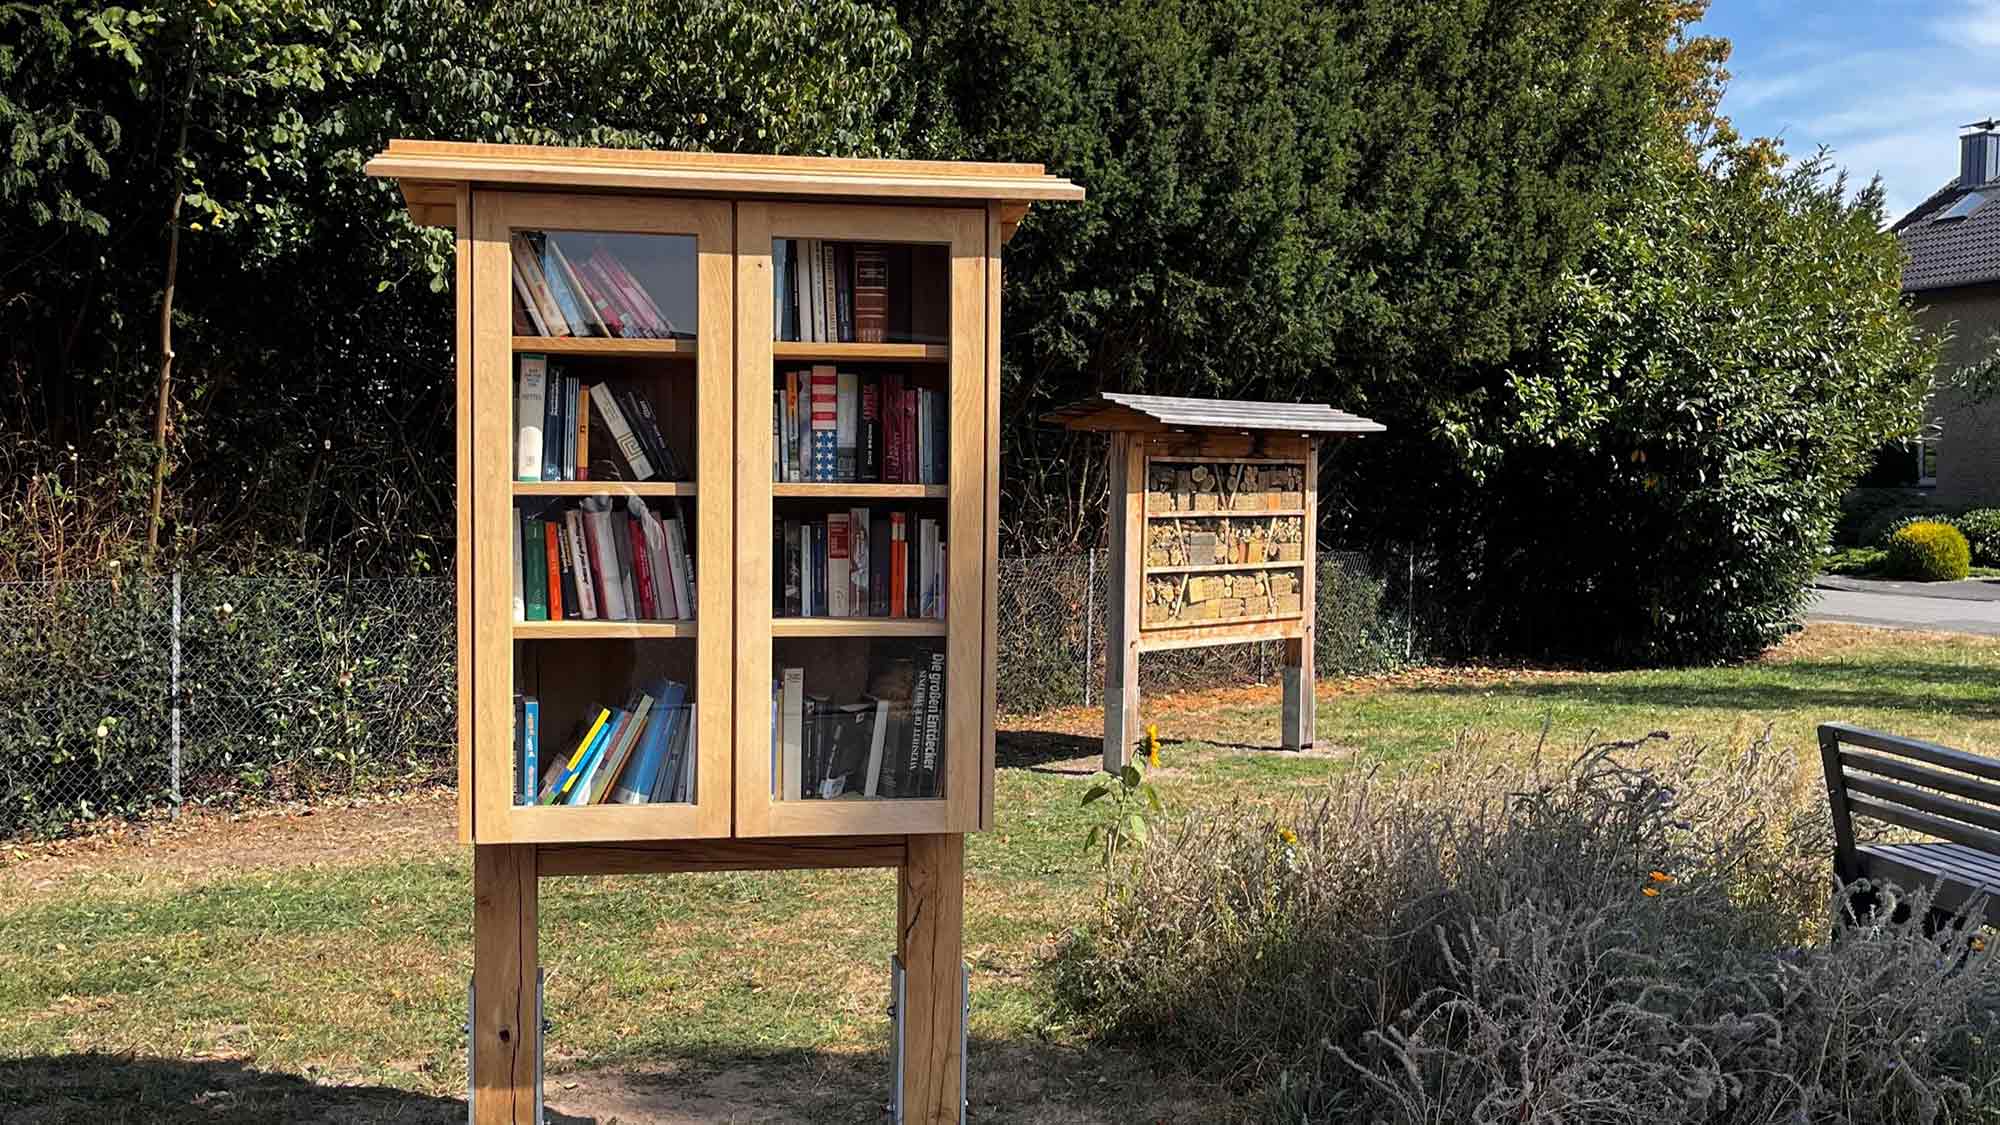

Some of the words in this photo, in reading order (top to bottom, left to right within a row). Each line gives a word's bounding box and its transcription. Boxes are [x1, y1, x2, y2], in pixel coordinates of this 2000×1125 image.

[931, 653, 944, 672] Die
[928, 673, 942, 713] großen
[923, 714, 938, 771] Entdecker
